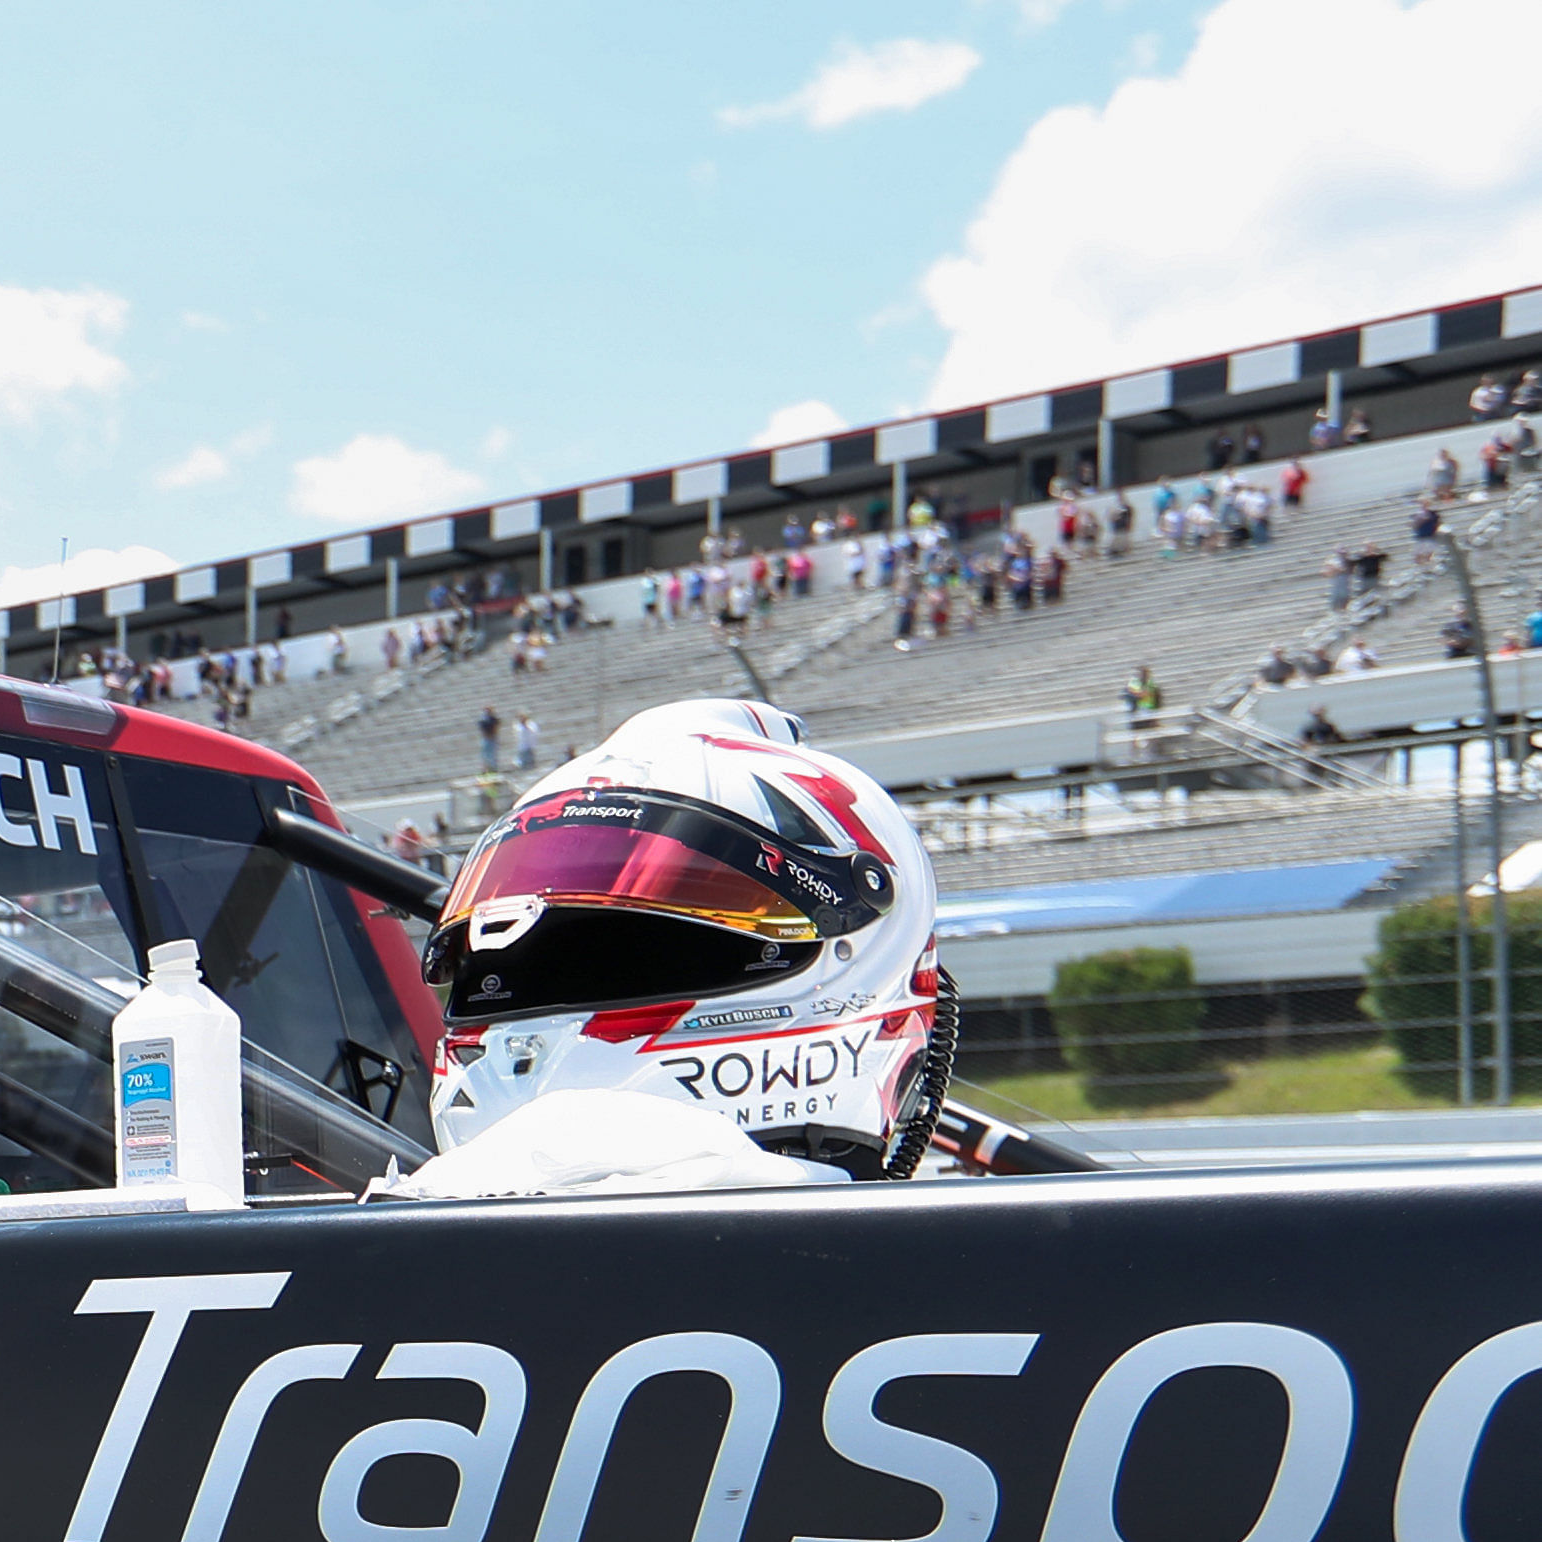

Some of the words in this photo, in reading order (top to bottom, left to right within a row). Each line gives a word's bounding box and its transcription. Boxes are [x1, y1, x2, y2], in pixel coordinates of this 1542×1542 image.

[563, 805, 643, 819] Transport
[784, 858, 843, 905] ROWDY
[127, 1073, 153, 1088] 70%
[659, 1029, 872, 1100] ROWDY
[735, 1093, 839, 1126] NERGY
